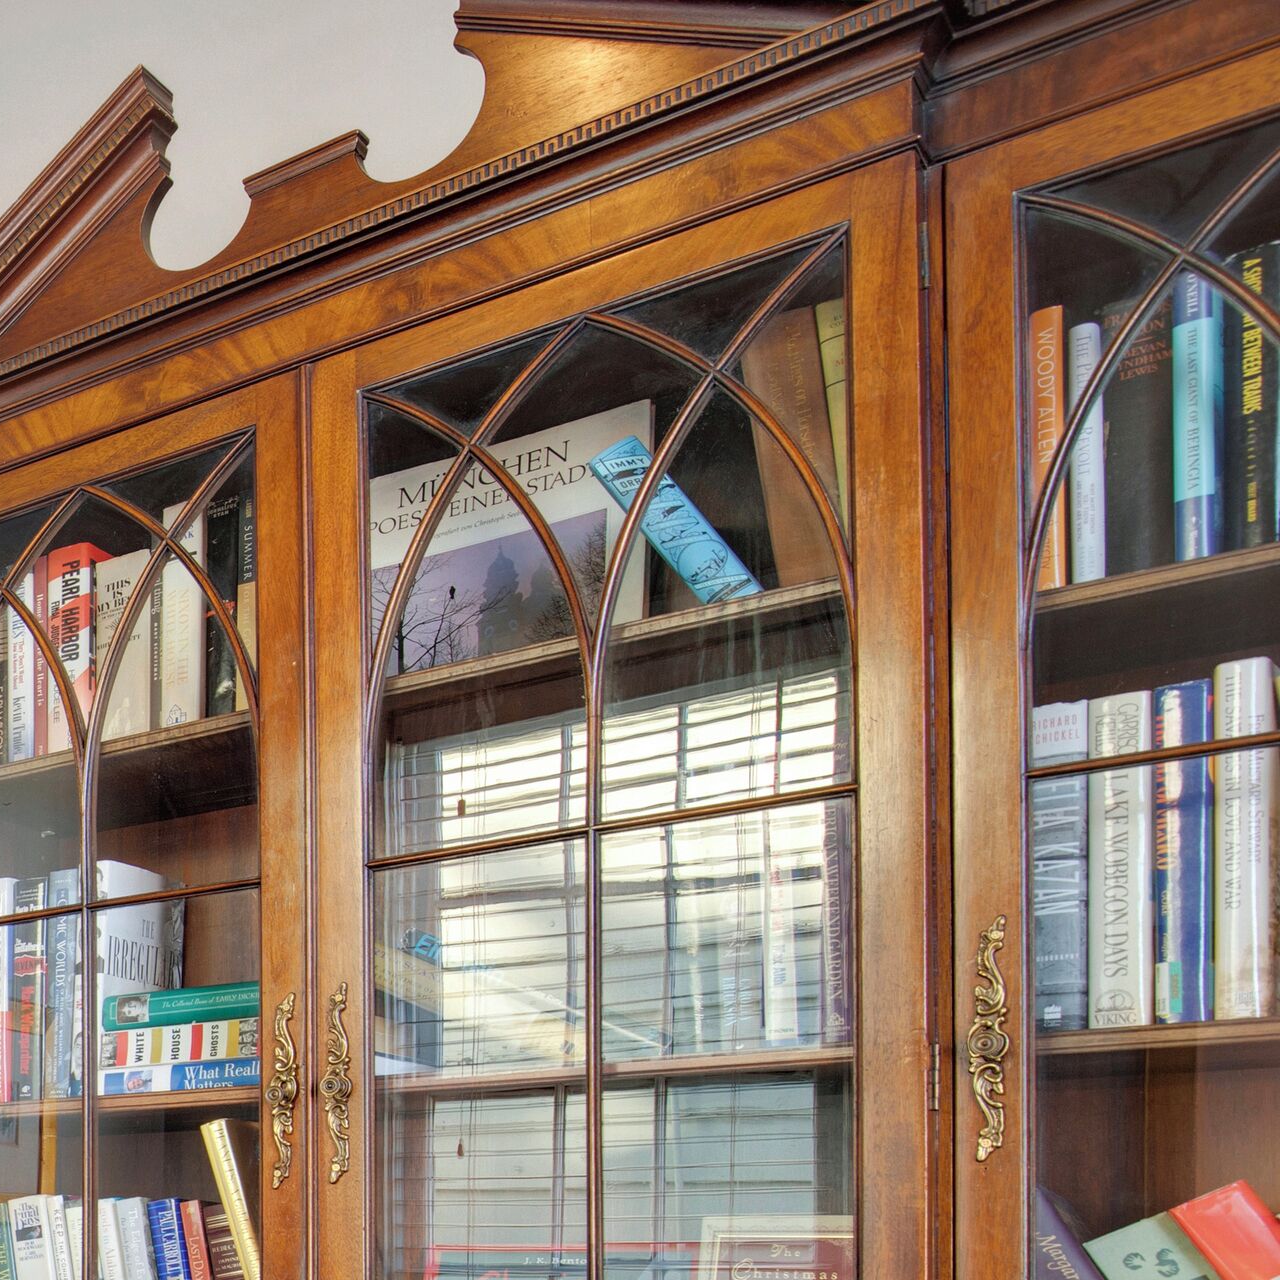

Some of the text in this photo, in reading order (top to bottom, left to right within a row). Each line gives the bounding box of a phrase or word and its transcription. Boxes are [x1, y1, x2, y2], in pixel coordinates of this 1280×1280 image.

[1242, 257, 1262, 270] A
[1187, 273, 1200, 315] O'NEILL
[1242, 329, 1263, 376] BETWEEN
[1119, 364, 1159, 381] LEWIS
[1036, 327, 1056, 465] WOODY ALLEN
[1242, 375, 1263, 415] TRAINS
[1187, 327, 1201, 491] THE LAST GIANT OF BERINGIA
[1076, 417, 1093, 477] REVOLT
[609, 457, 645, 470] IMMY
[212, 509, 230, 518] RYAN
[243, 525, 253, 581] SUMMER
[104, 577, 131, 593] THIS
[111, 588, 123, 601] IS
[50, 601, 60, 620] FINAL
[61, 560, 80, 662] PEARL HARBOR
[97, 602, 111, 614] MY
[151, 588, 162, 614] thing
[11, 696, 25, 722] Kevin
[1247, 806, 1265, 864] STEWART
[1224, 797, 1242, 911] LOVE AND WAR
[1032, 840, 1080, 917] KAZAN
[1103, 774, 1131, 979] LAKE WOBEGON DAYS
[141, 918, 155, 940] THE
[826, 863, 845, 1001] WEEKEND GARDEN
[55, 898, 68, 987] CMIC WORLDS
[216, 993, 237, 1003] EMILY
[1093, 1010, 1137, 1026] VIKING
[134, 1024, 220, 1063] WHITE HOUSE GHOSTS
[184, 1063, 220, 1080] What
[184, 1078, 234, 1090] Matters
[15, 1217, 41, 1230] Days
[53, 1209, 64, 1237] KEEP
[126, 1207, 138, 1229] The
[158, 1210, 172, 1232] PAUL
[130, 1229, 143, 1258] Edge
[189, 1236, 201, 1260] LAST
[770, 1243, 802, 1258] The
[522, 1256, 587, 1265] J. K. Bento
